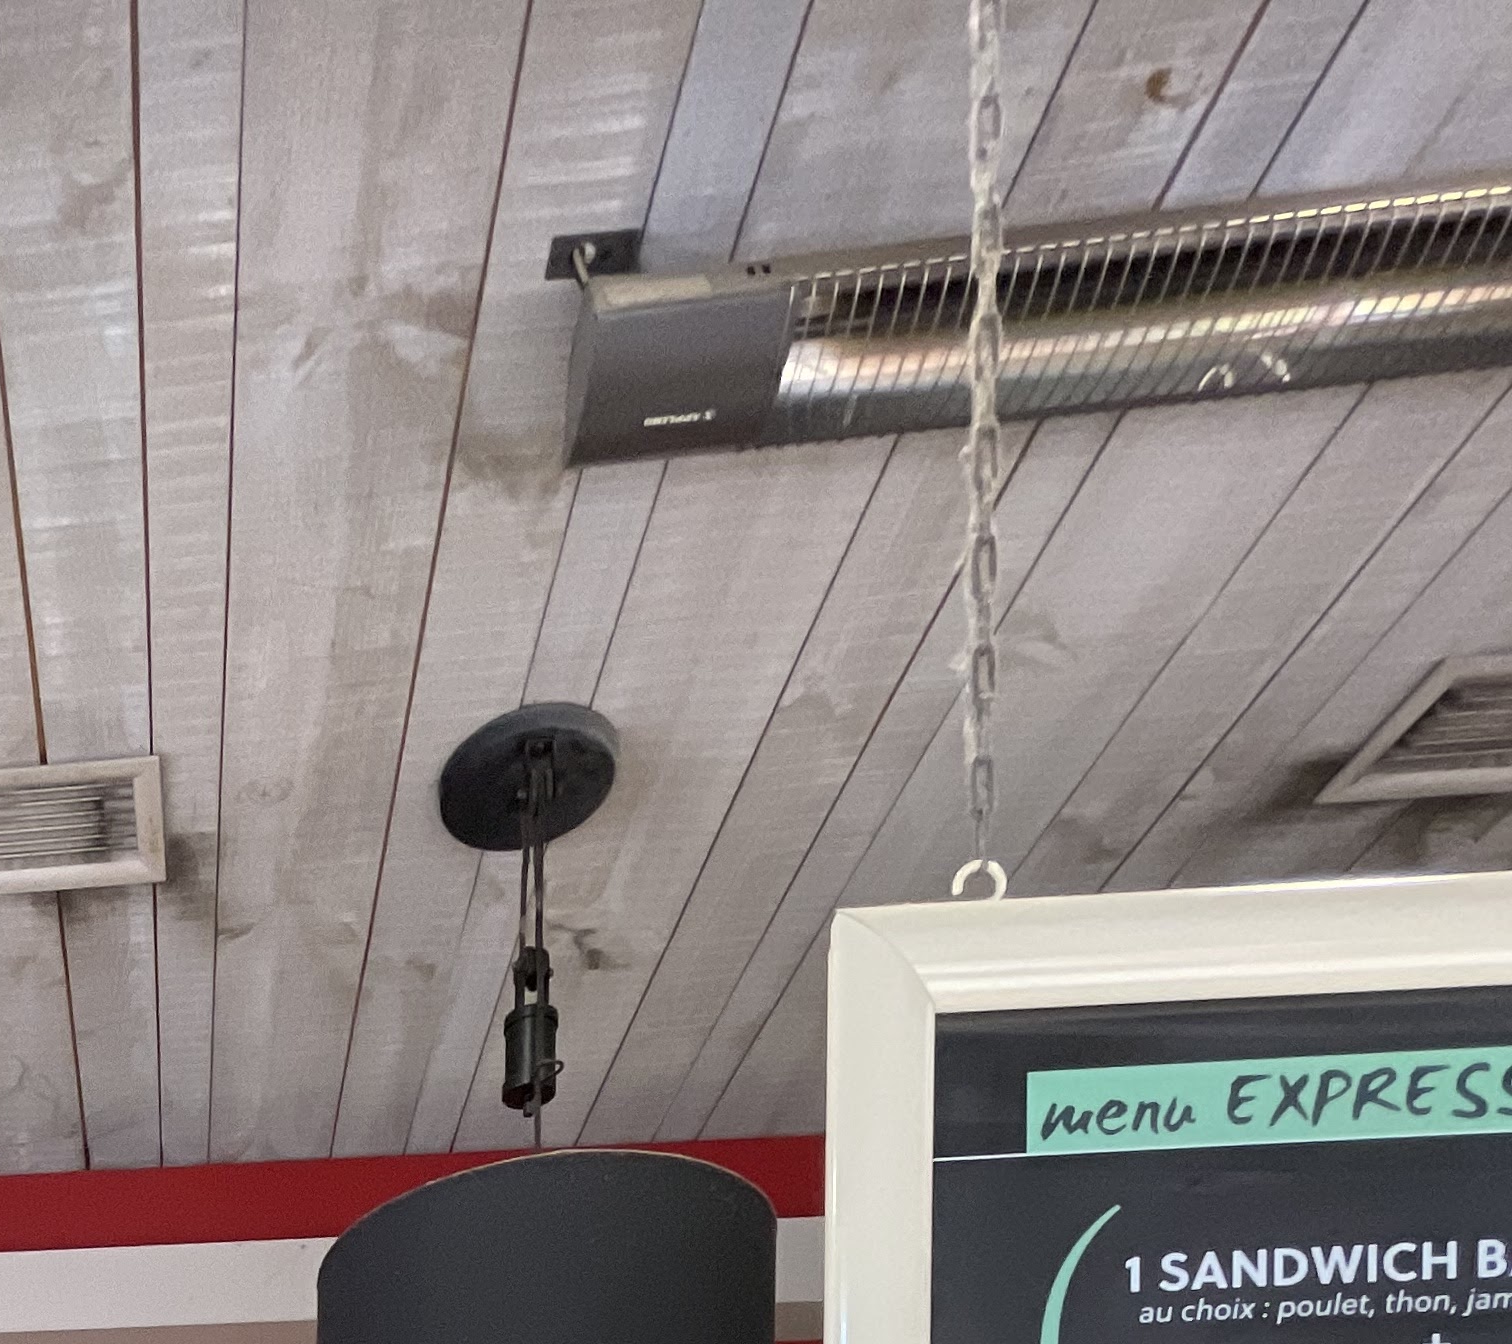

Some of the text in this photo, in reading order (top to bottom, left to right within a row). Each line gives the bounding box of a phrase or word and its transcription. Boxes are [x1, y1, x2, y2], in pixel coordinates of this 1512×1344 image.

[1040, 1095, 1196, 1141] menu
[1124, 1238, 1512, 1293] 1 SANDWICH B
[1138, 1303, 1173, 1325] au
[1180, 1297, 1255, 1323] choix
[1275, 1292, 1376, 1326] poulet,
[1384, 1290, 1458, 1317] thon,
